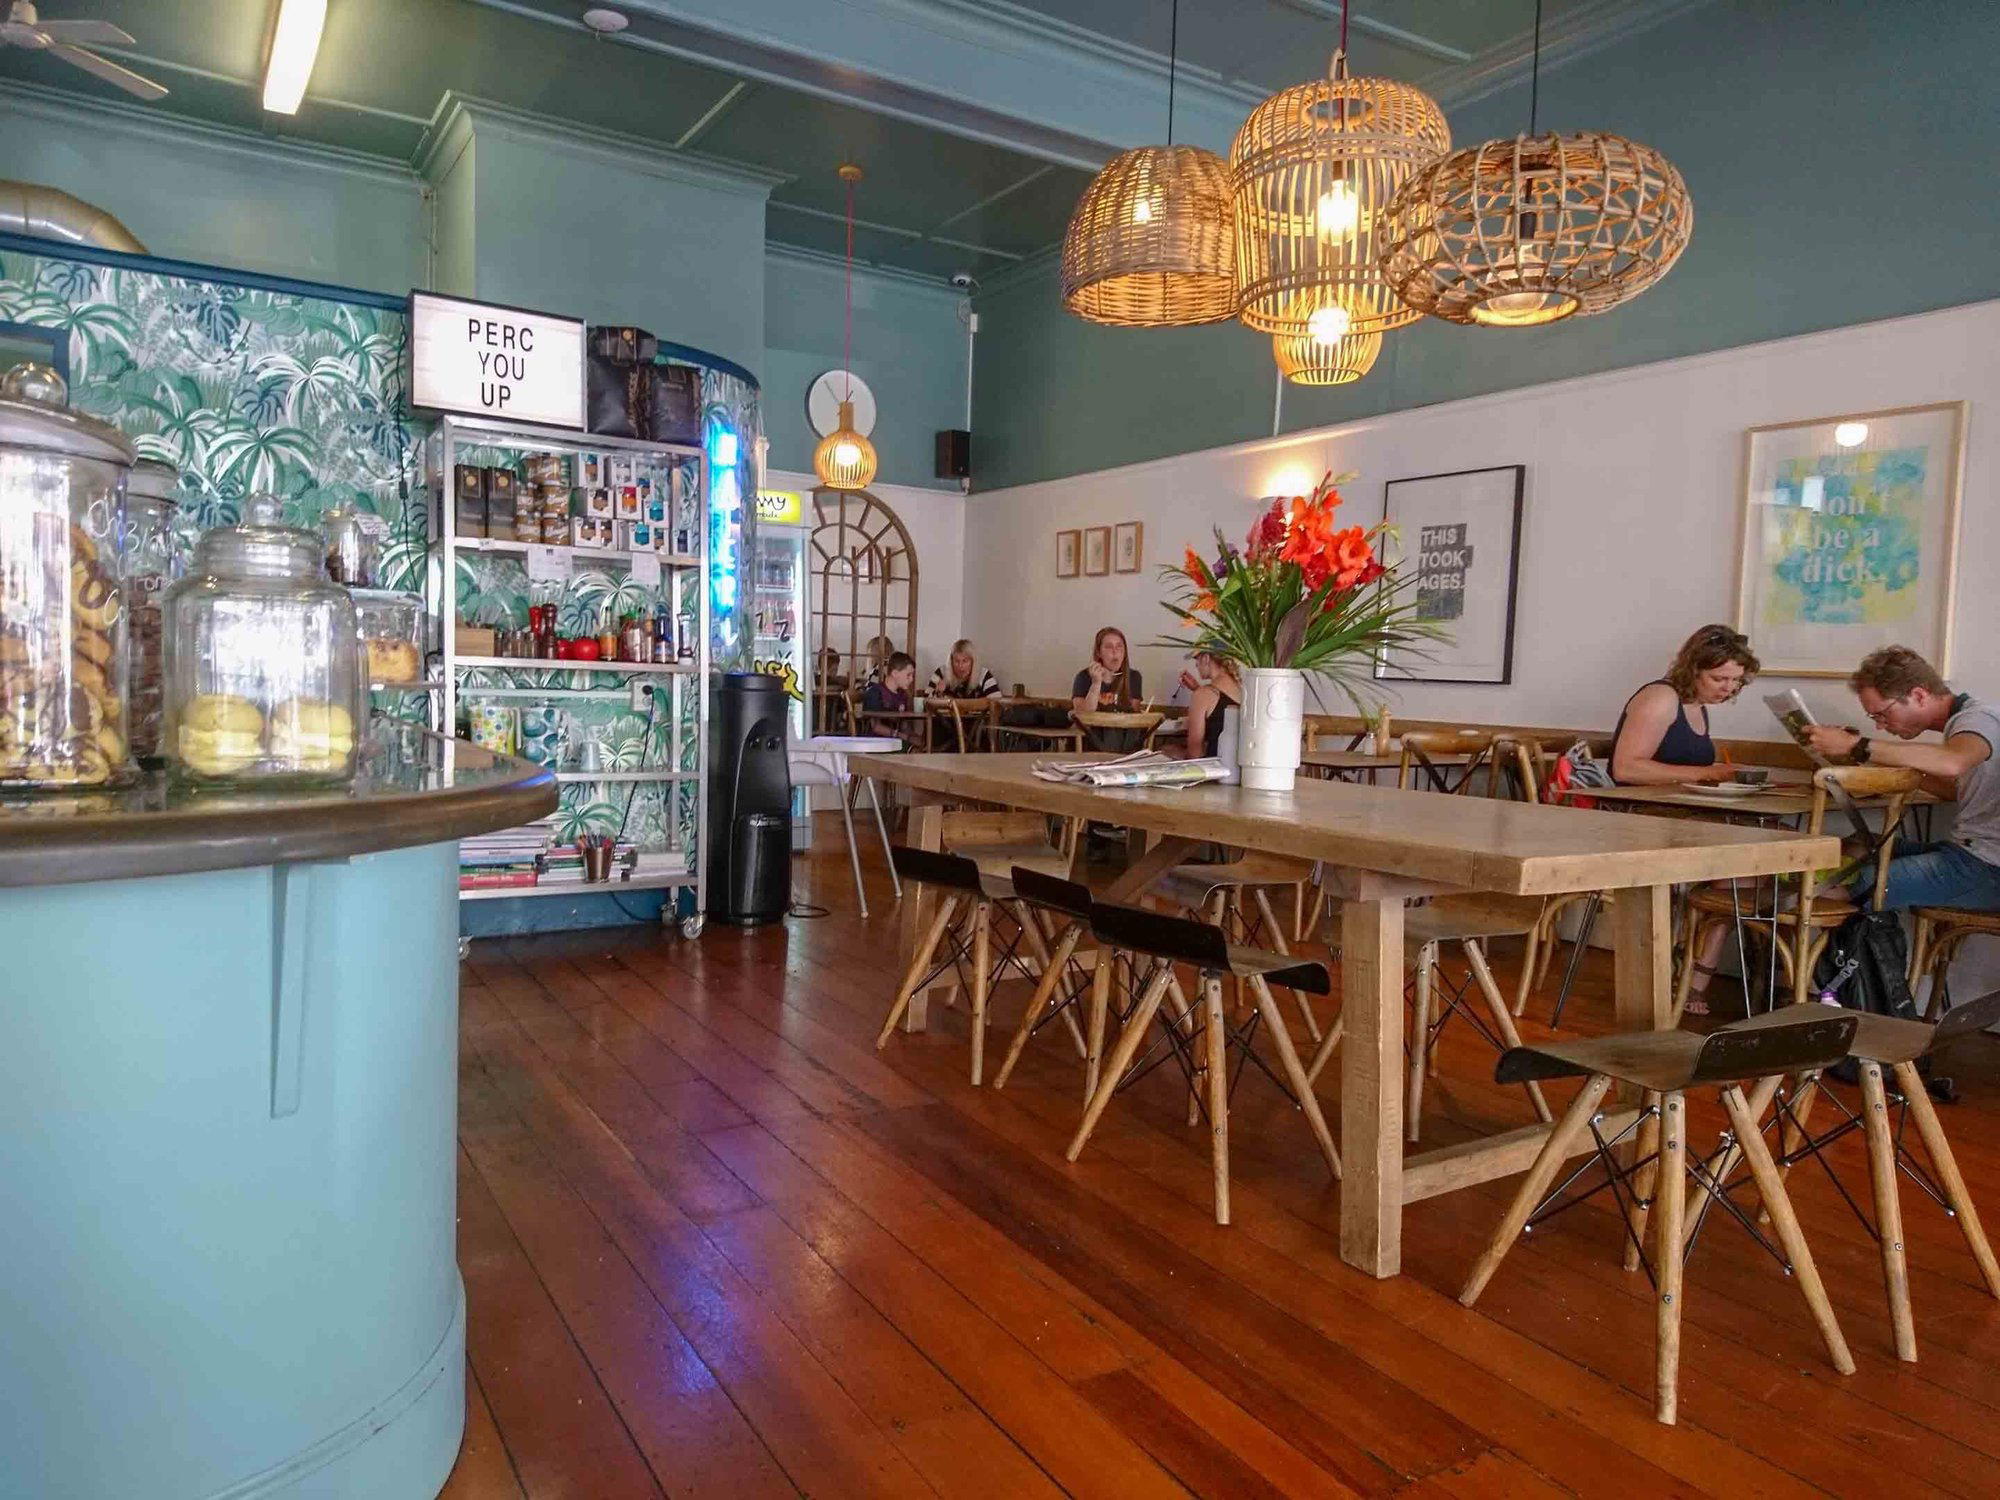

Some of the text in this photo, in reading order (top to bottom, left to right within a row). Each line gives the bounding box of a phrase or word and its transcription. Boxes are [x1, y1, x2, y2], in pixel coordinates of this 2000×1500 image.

[468, 318, 534, 352] PERC
[478, 350, 525, 381] YOU
[481, 382, 511, 408] UP
[1421, 528, 1457, 546] THIS
[1419, 550, 1466, 568] TOOK
